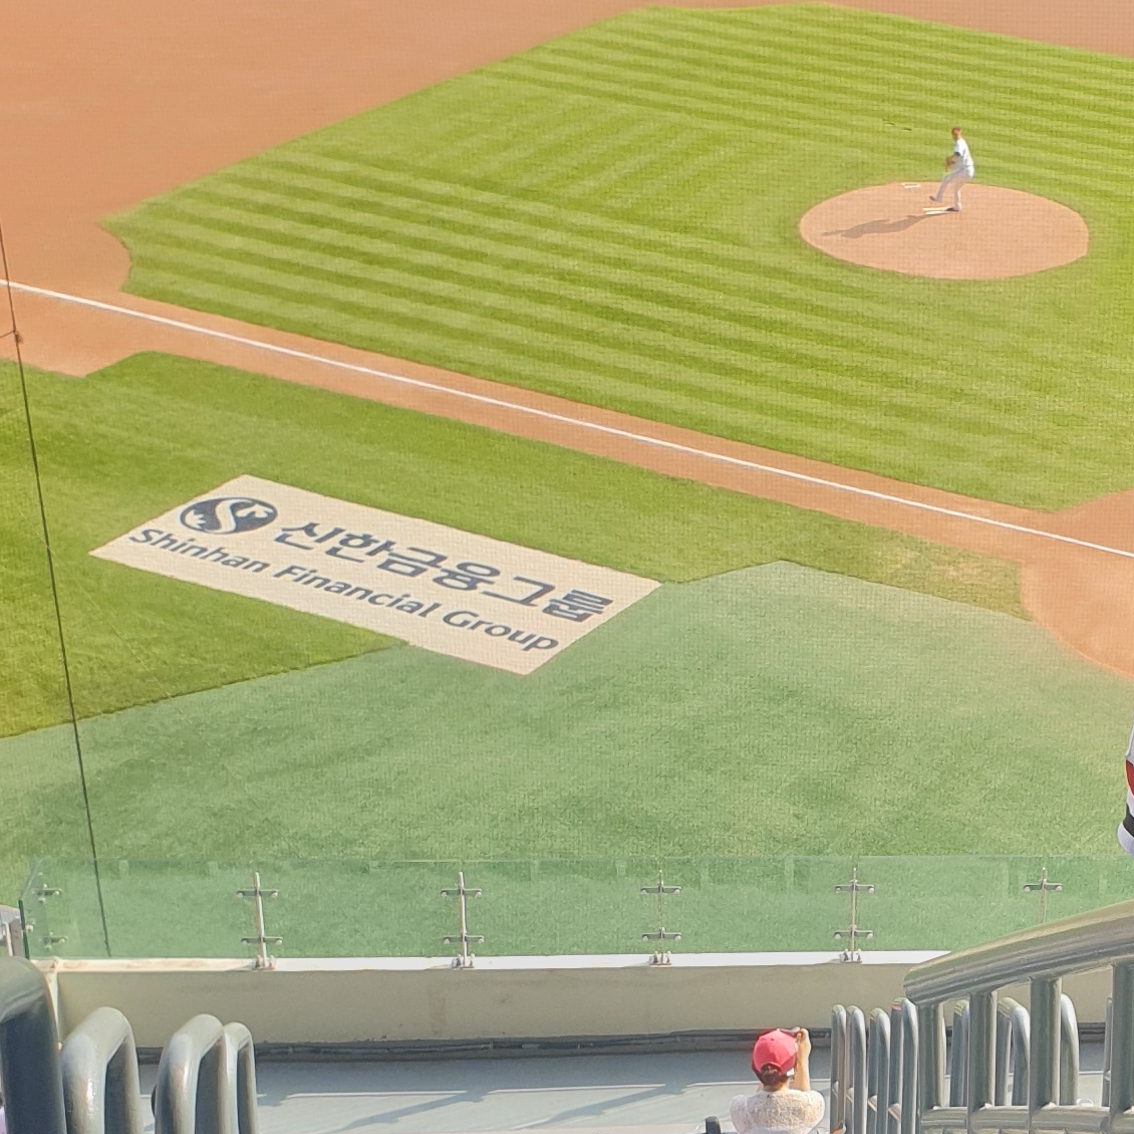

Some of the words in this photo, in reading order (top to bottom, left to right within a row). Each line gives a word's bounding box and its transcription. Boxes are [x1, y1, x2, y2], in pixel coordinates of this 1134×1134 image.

[128, 528, 271, 574] Shinhan
[272, 565, 442, 618] Financial
[442, 610, 559, 652] Group
[273, 521, 614, 622] 신한금융그룹
